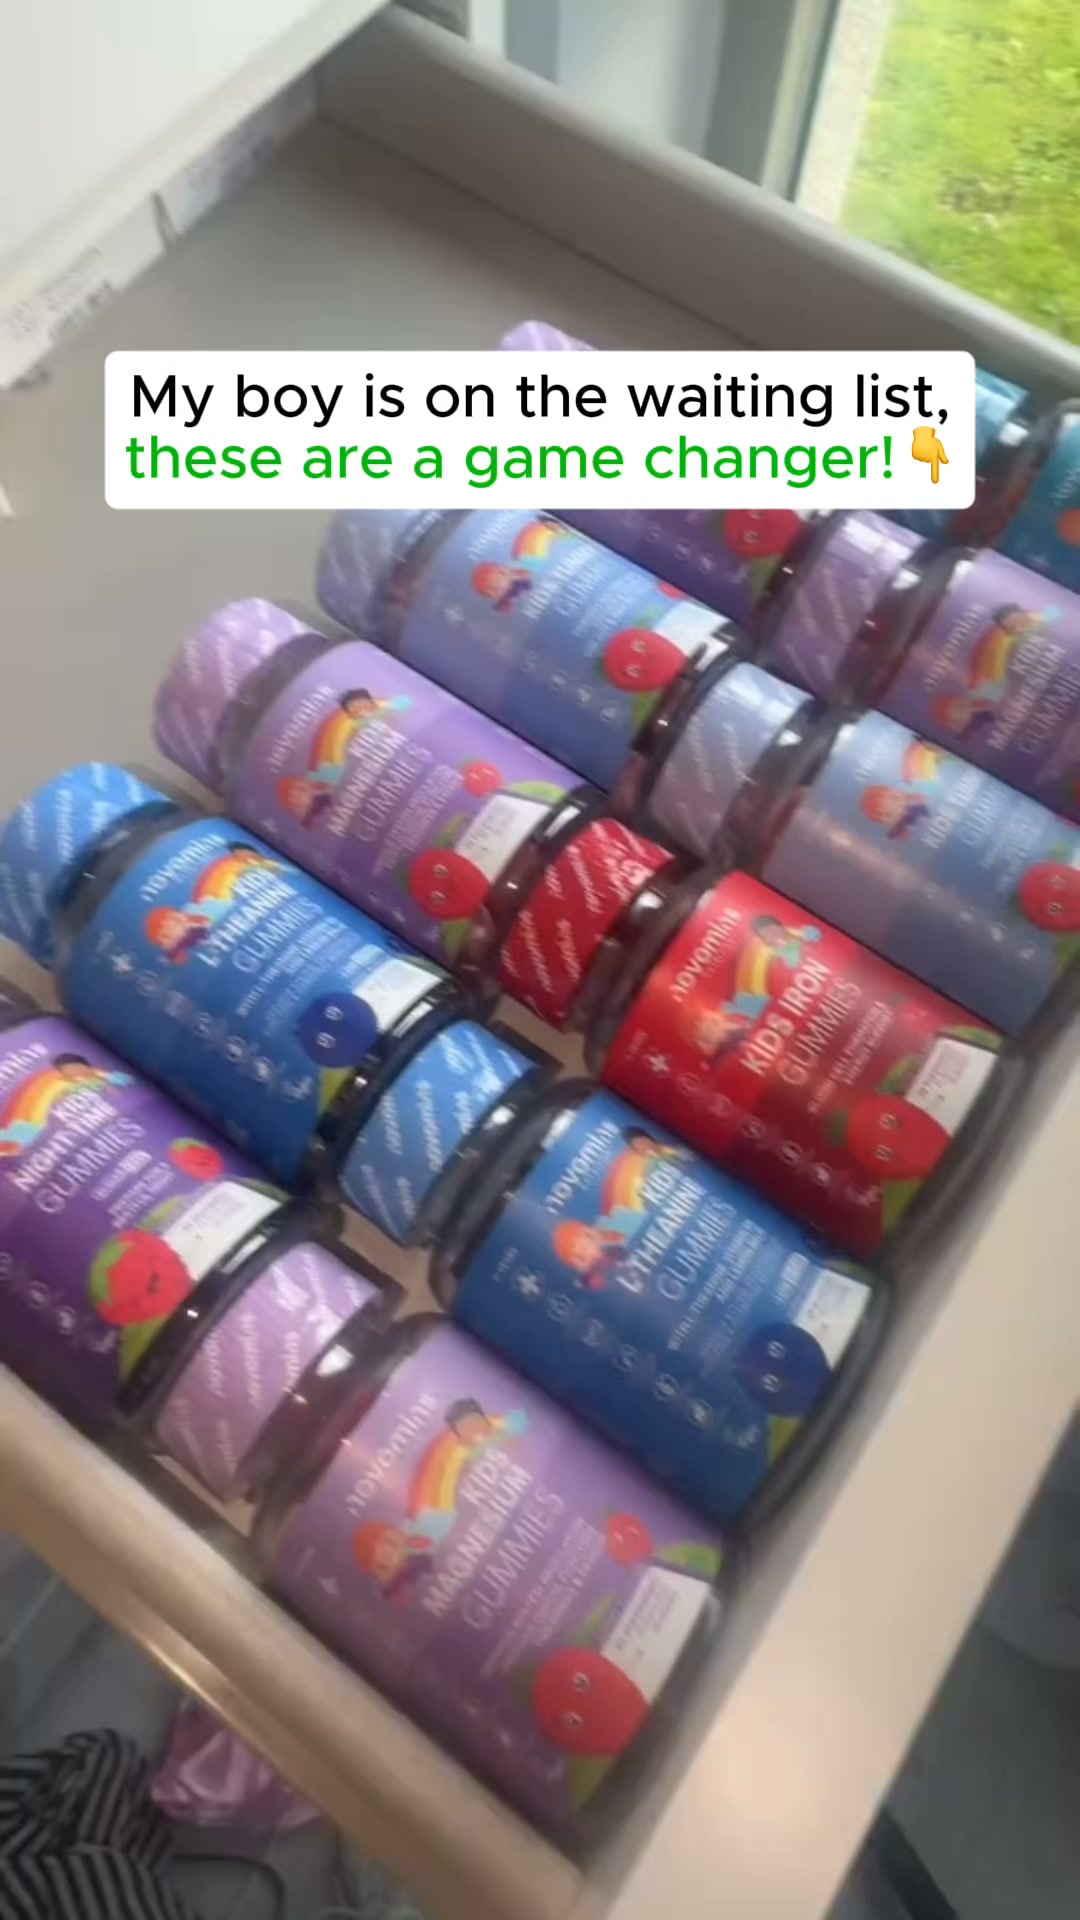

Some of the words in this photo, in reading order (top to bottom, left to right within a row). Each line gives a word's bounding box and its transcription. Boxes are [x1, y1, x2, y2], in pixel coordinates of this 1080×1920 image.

[740, 1013, 795, 1079] KIDS
[779, 956, 832, 1020] IRON
[776, 974, 863, 1088] GUMMIES
[10, 1127, 78, 1193] NIGHT
[32, 1116, 146, 1213] GUMMIES
[640, 1161, 682, 1204] KIDS
[656, 1195, 737, 1301] GUMMIES
[459, 1445, 511, 1506] KIDS
[421, 1463, 534, 1617] MAGNESIUM
[459, 1485, 565, 1630] GUMMIES
